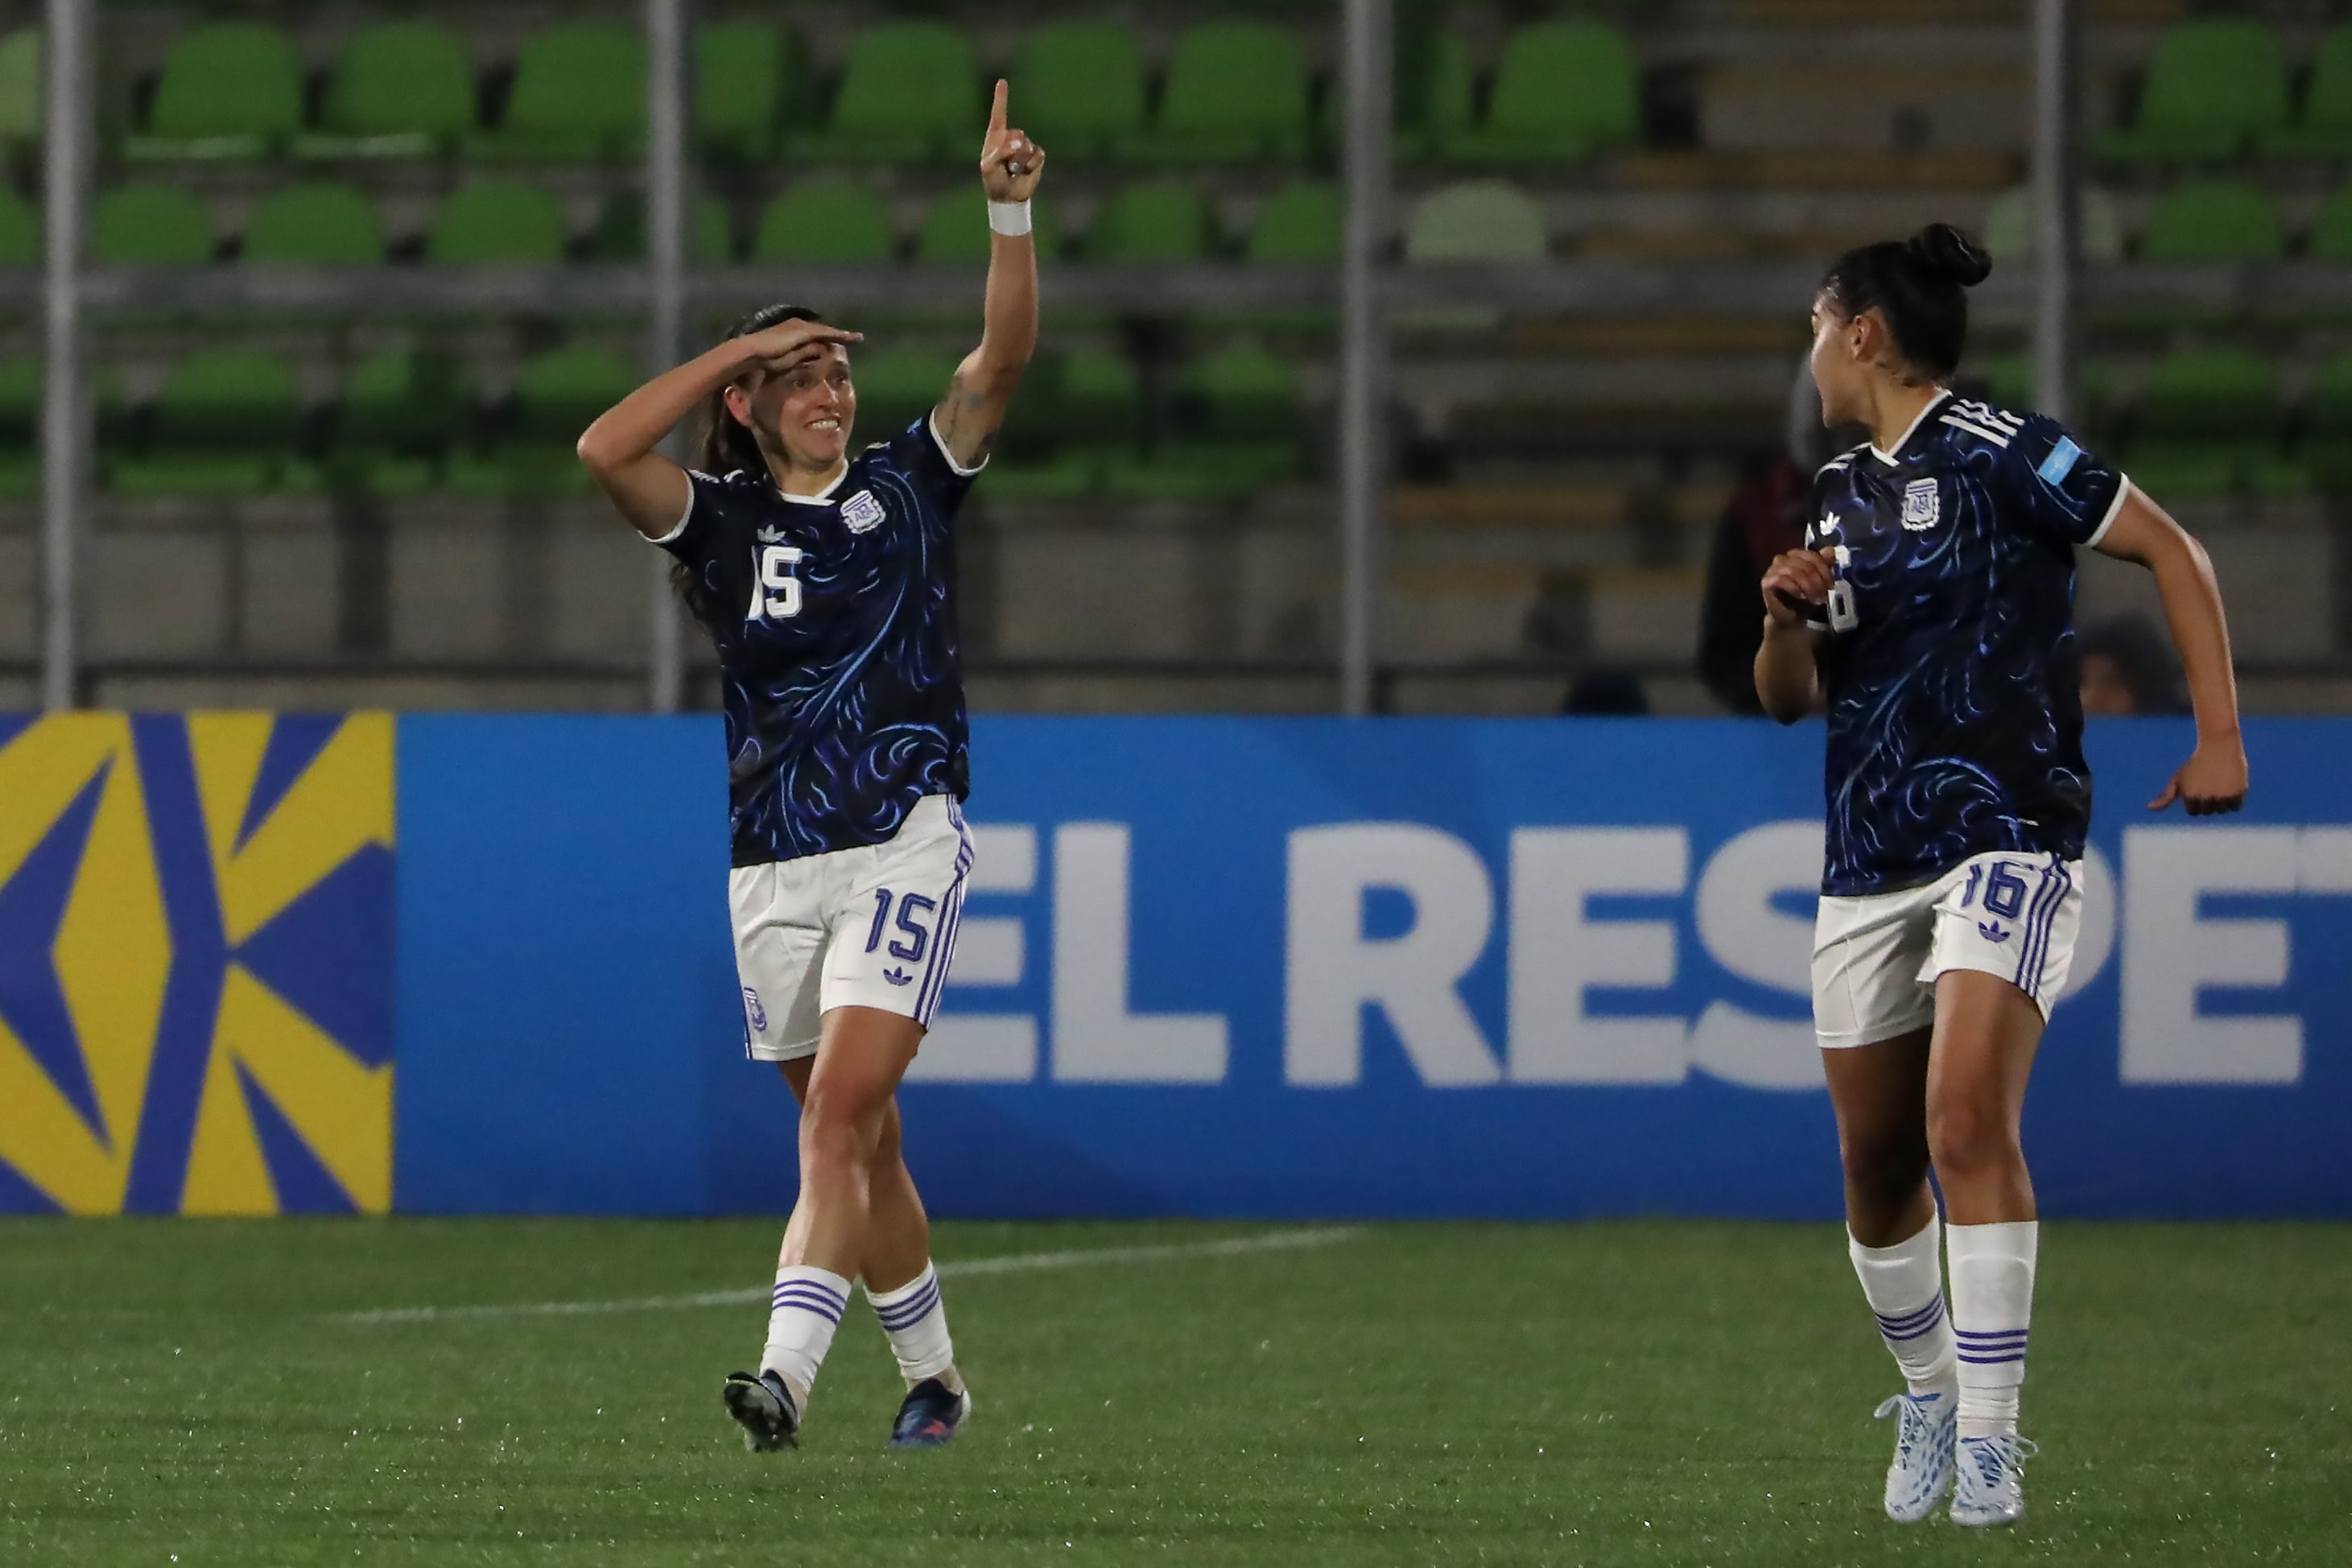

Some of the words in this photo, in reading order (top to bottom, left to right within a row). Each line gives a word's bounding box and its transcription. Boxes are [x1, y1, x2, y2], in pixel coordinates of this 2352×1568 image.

[748, 545, 803, 619] 15
[864, 886, 937, 963] 15
[1962, 861, 2033, 918] 16
